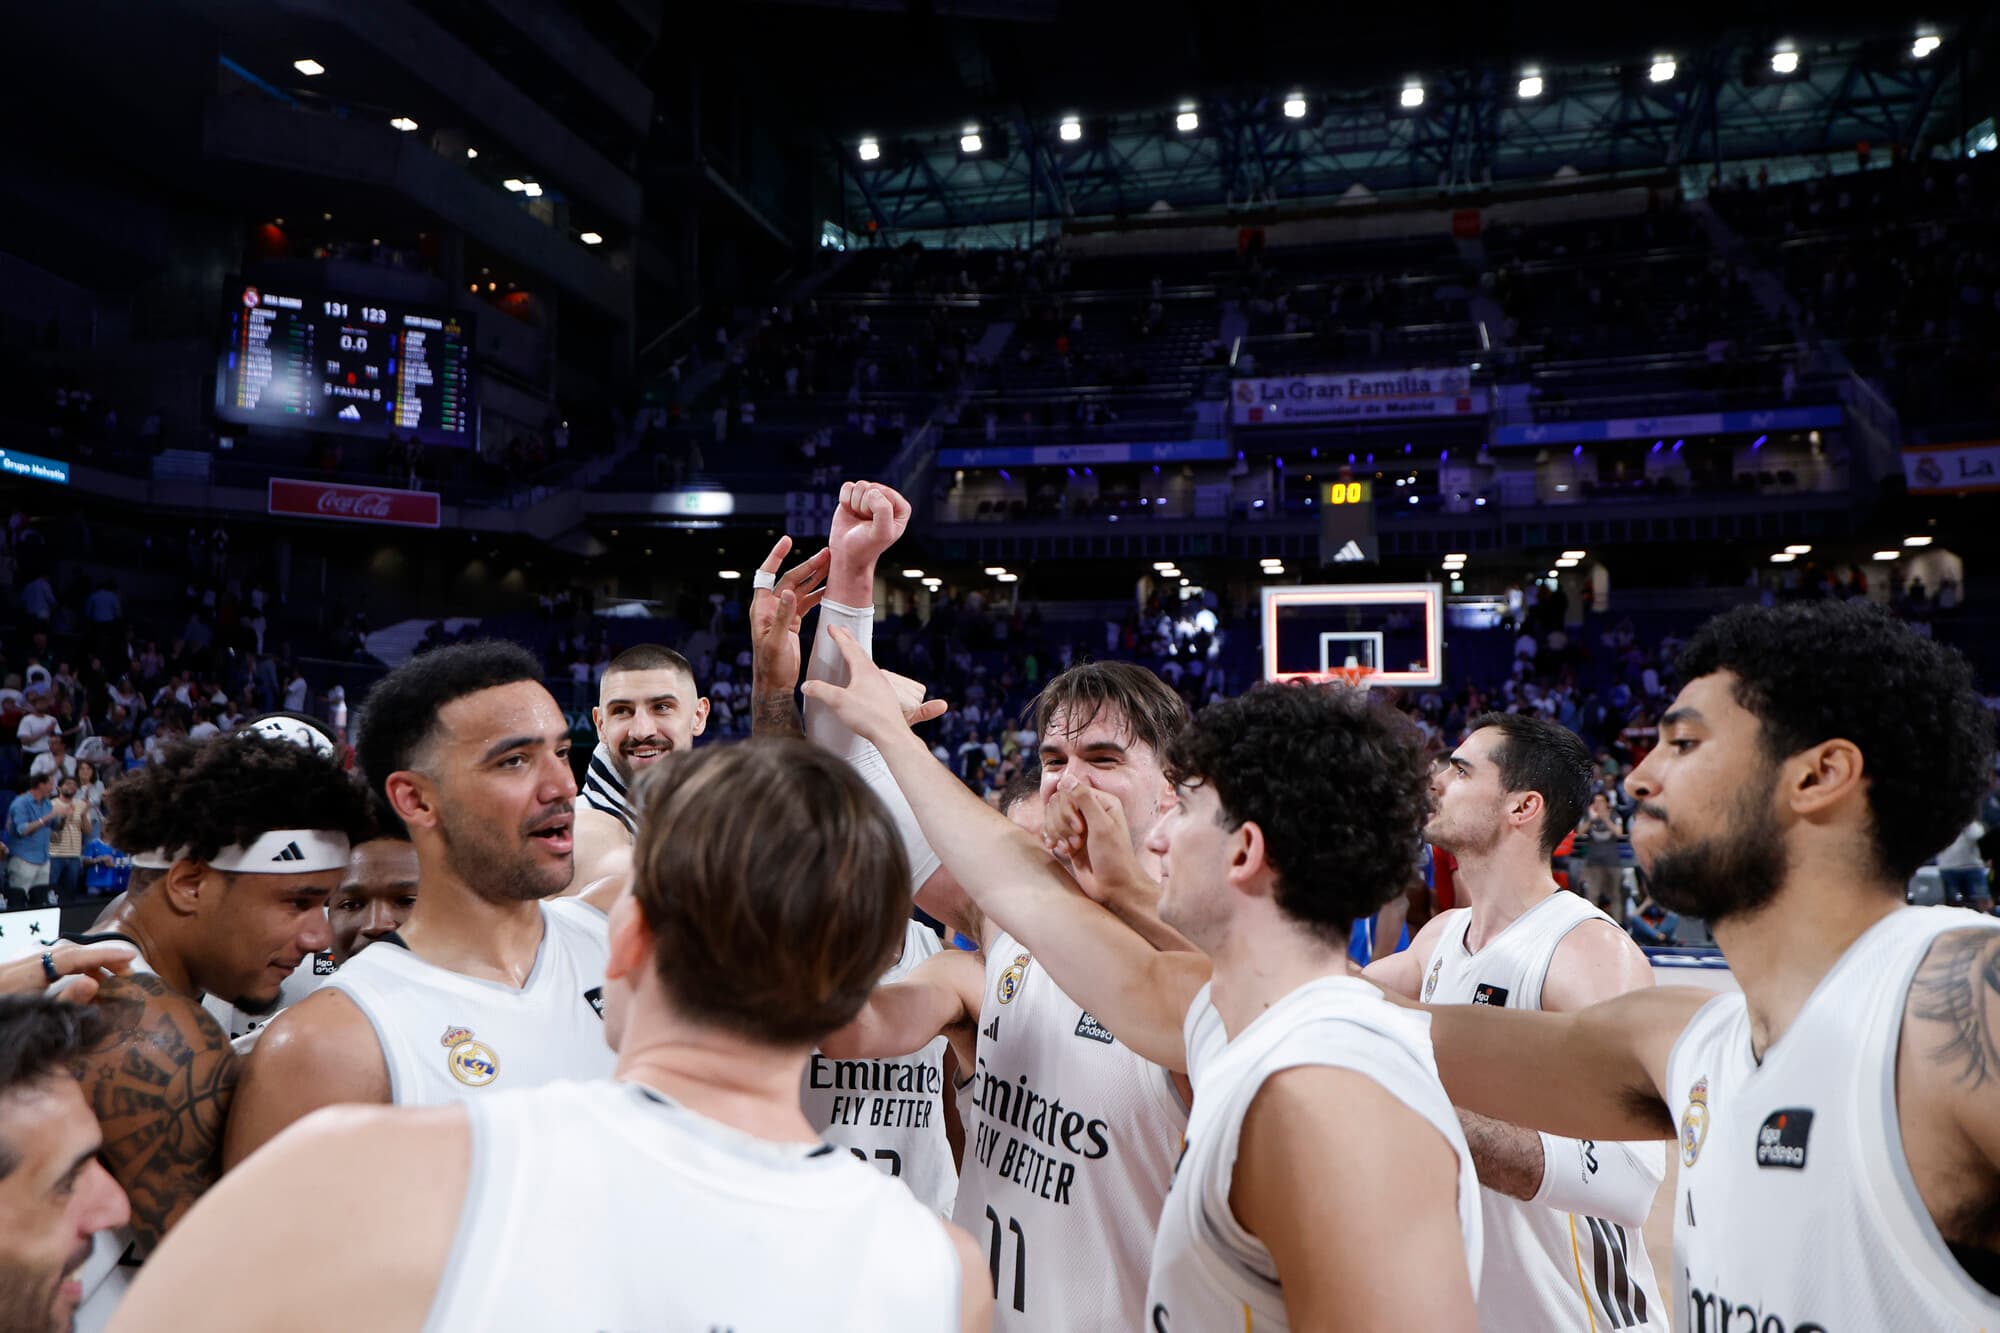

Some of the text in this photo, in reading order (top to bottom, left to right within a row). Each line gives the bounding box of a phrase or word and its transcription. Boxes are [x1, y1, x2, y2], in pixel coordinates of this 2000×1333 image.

[323, 301, 348, 318] 131
[362, 307, 387, 324] 123
[340, 335, 368, 352] 0.0
[1260, 376, 1432, 400] La Gran Familia
[3, 457, 30, 474] Grupo
[316, 959, 332, 971] liga
[1079, 1024, 1113, 1040] endesa
[831, 1096, 932, 1128] FLY BETTER
[975, 1121, 1075, 1205] FLY BETTER
[1759, 1145, 1804, 1165] endesa
[986, 1204, 1025, 1313] 11
